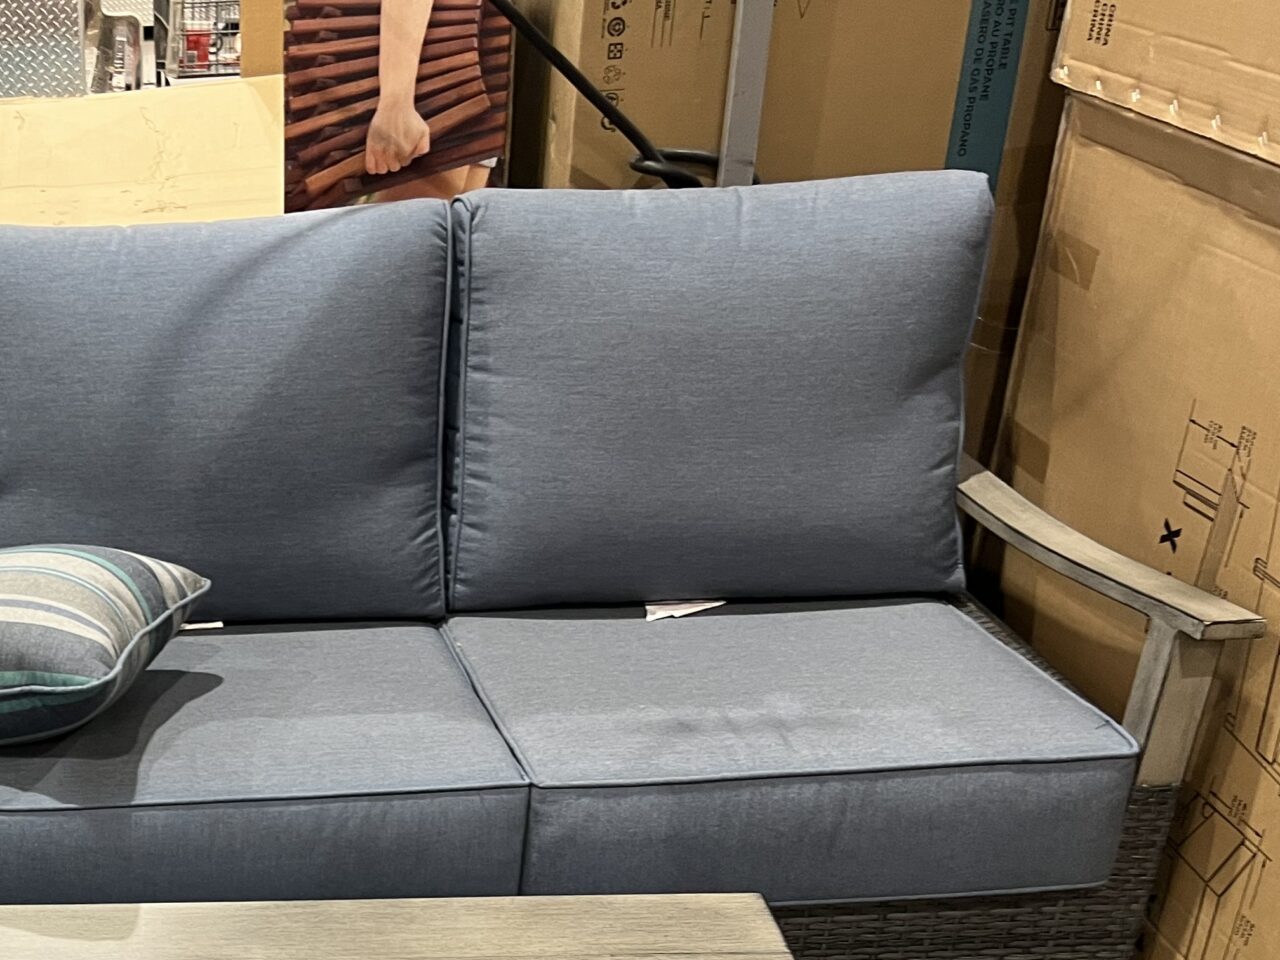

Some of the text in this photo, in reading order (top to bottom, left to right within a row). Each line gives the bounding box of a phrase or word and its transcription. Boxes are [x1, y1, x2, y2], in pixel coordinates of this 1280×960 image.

[1094, 3, 1109, 45] CHINE
[1101, 4, 1117, 46] CHINA
[979, 41, 999, 102] PROPANE
[998, 31, 1013, 71] TABLE
[968, 68, 982, 94] GAS
[957, 96, 976, 158] PROPANO
